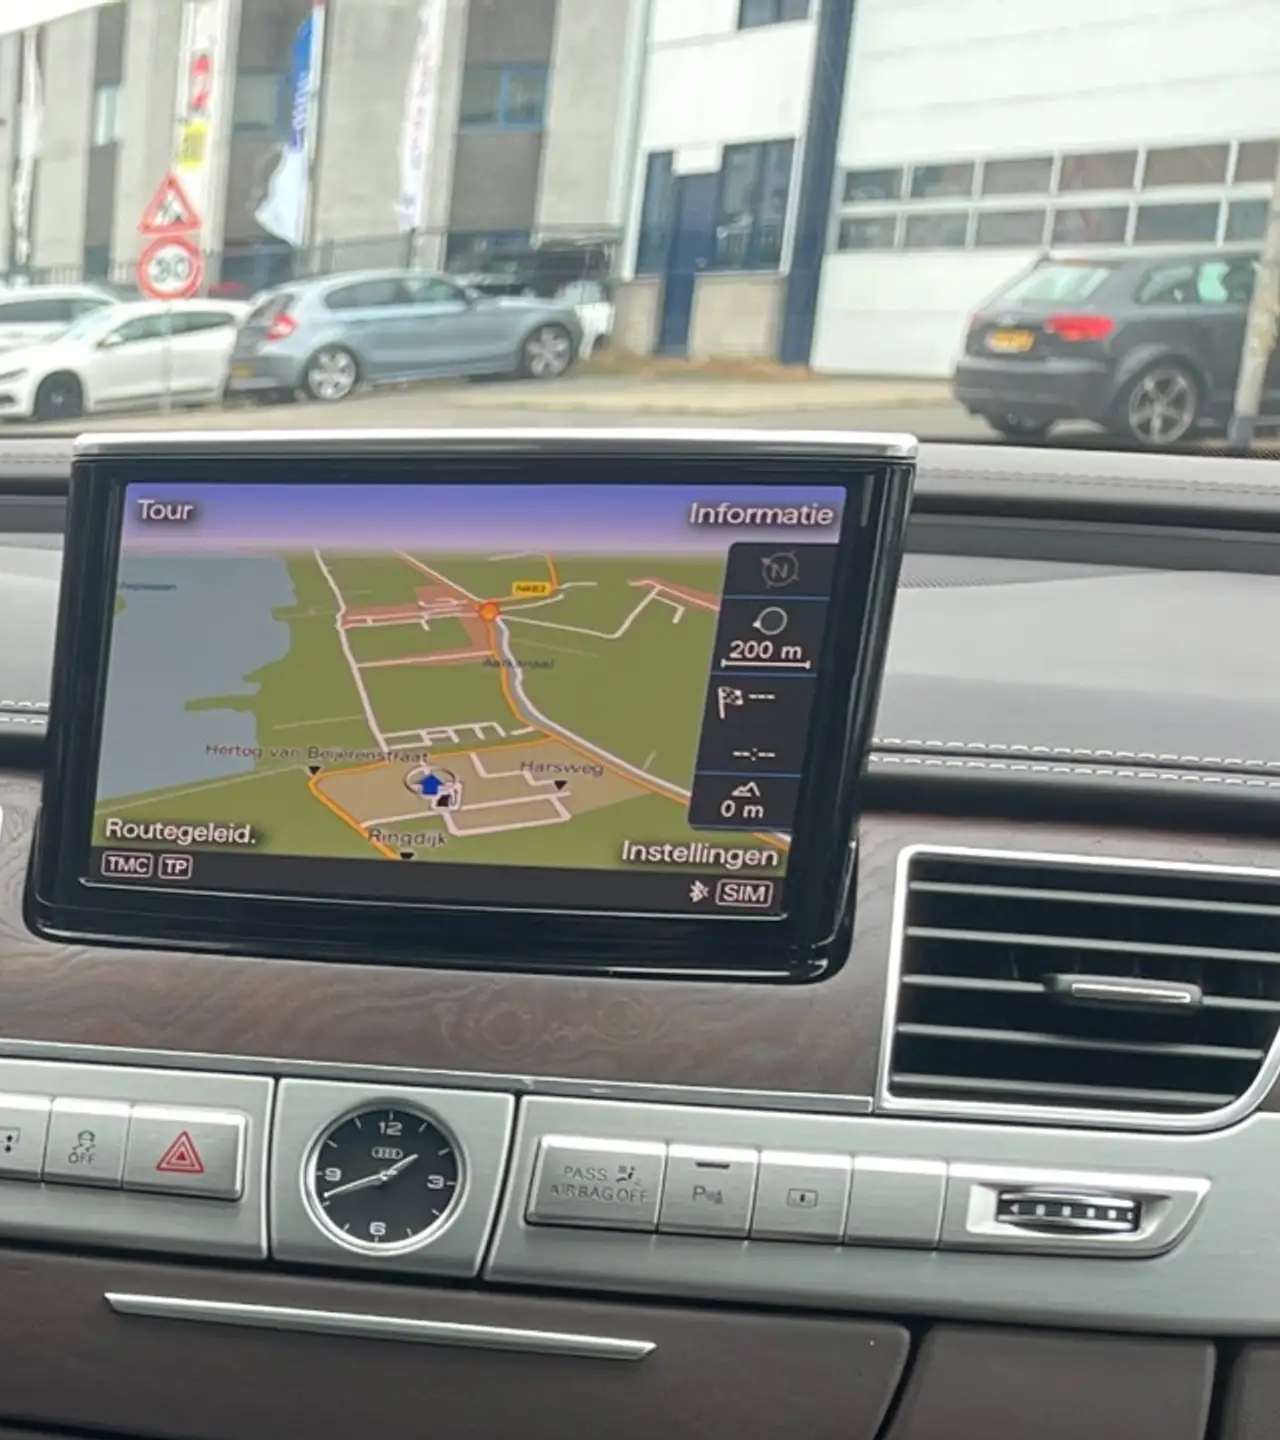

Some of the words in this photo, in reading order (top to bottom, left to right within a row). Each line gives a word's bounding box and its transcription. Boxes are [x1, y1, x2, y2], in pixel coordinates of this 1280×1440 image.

[155, 254, 189, 282] 30
[137, 499, 193, 520] Tour
[689, 502, 835, 525] Informatie
[729, 640, 773, 660] 200
[781, 644, 802, 660] m
[206, 744, 262, 758] Hertog
[521, 760, 604, 777] Harsweg
[721, 801, 735, 818] 0
[743, 805, 764, 818] m
[106, 819, 256, 845] Routegeleid.
[369, 828, 447, 846] Ringdijk
[622, 840, 779, 870] Instellingen
[107, 857, 149, 874] TMC
[164, 859, 187, 875] TP
[723, 884, 766, 902] SIM
[378, 1121, 403, 1136] 12
[324, 1167, 342, 1182] 9
[563, 1165, 608, 1182] PASS
[426, 1175, 445, 1190] 3
[549, 1183, 614, 1201] AIRBAG
[369, 1222, 387, 1236] 6
